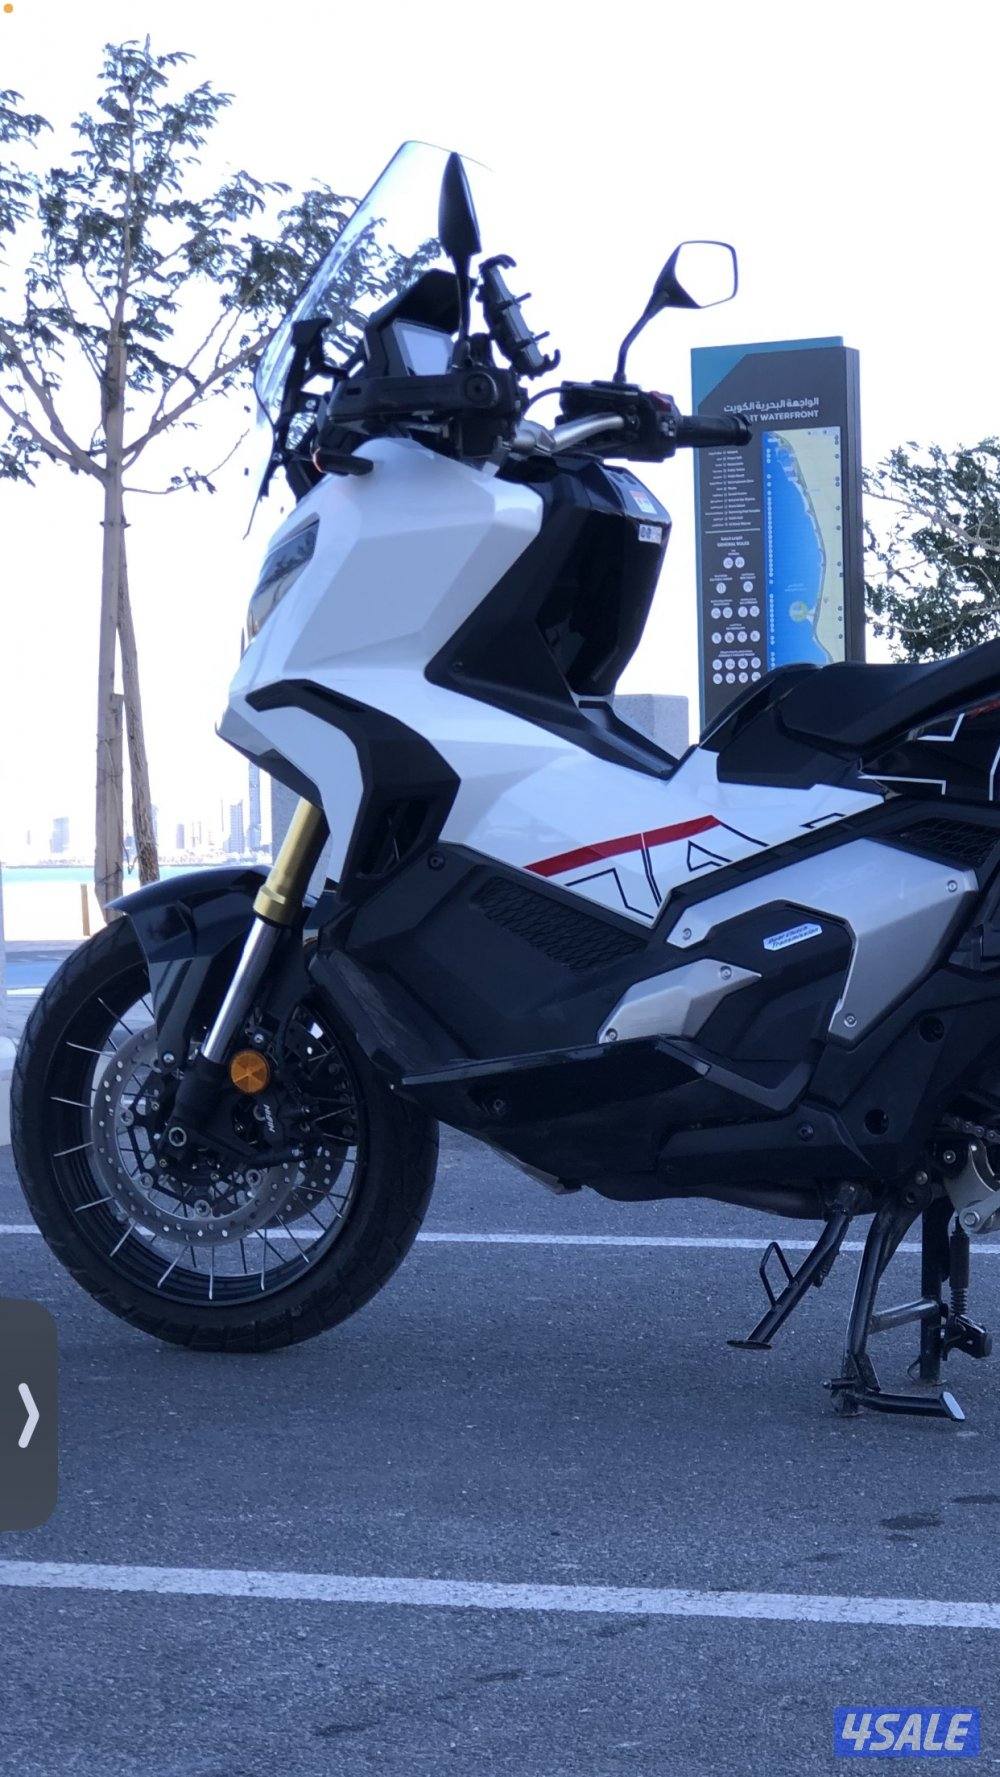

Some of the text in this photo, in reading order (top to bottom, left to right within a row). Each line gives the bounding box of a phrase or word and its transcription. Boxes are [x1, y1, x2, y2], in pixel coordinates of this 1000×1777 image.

[723, 397, 819, 414] الواجهة البحرية الكويت
[760, 410, 819, 421] WATERFRONT
